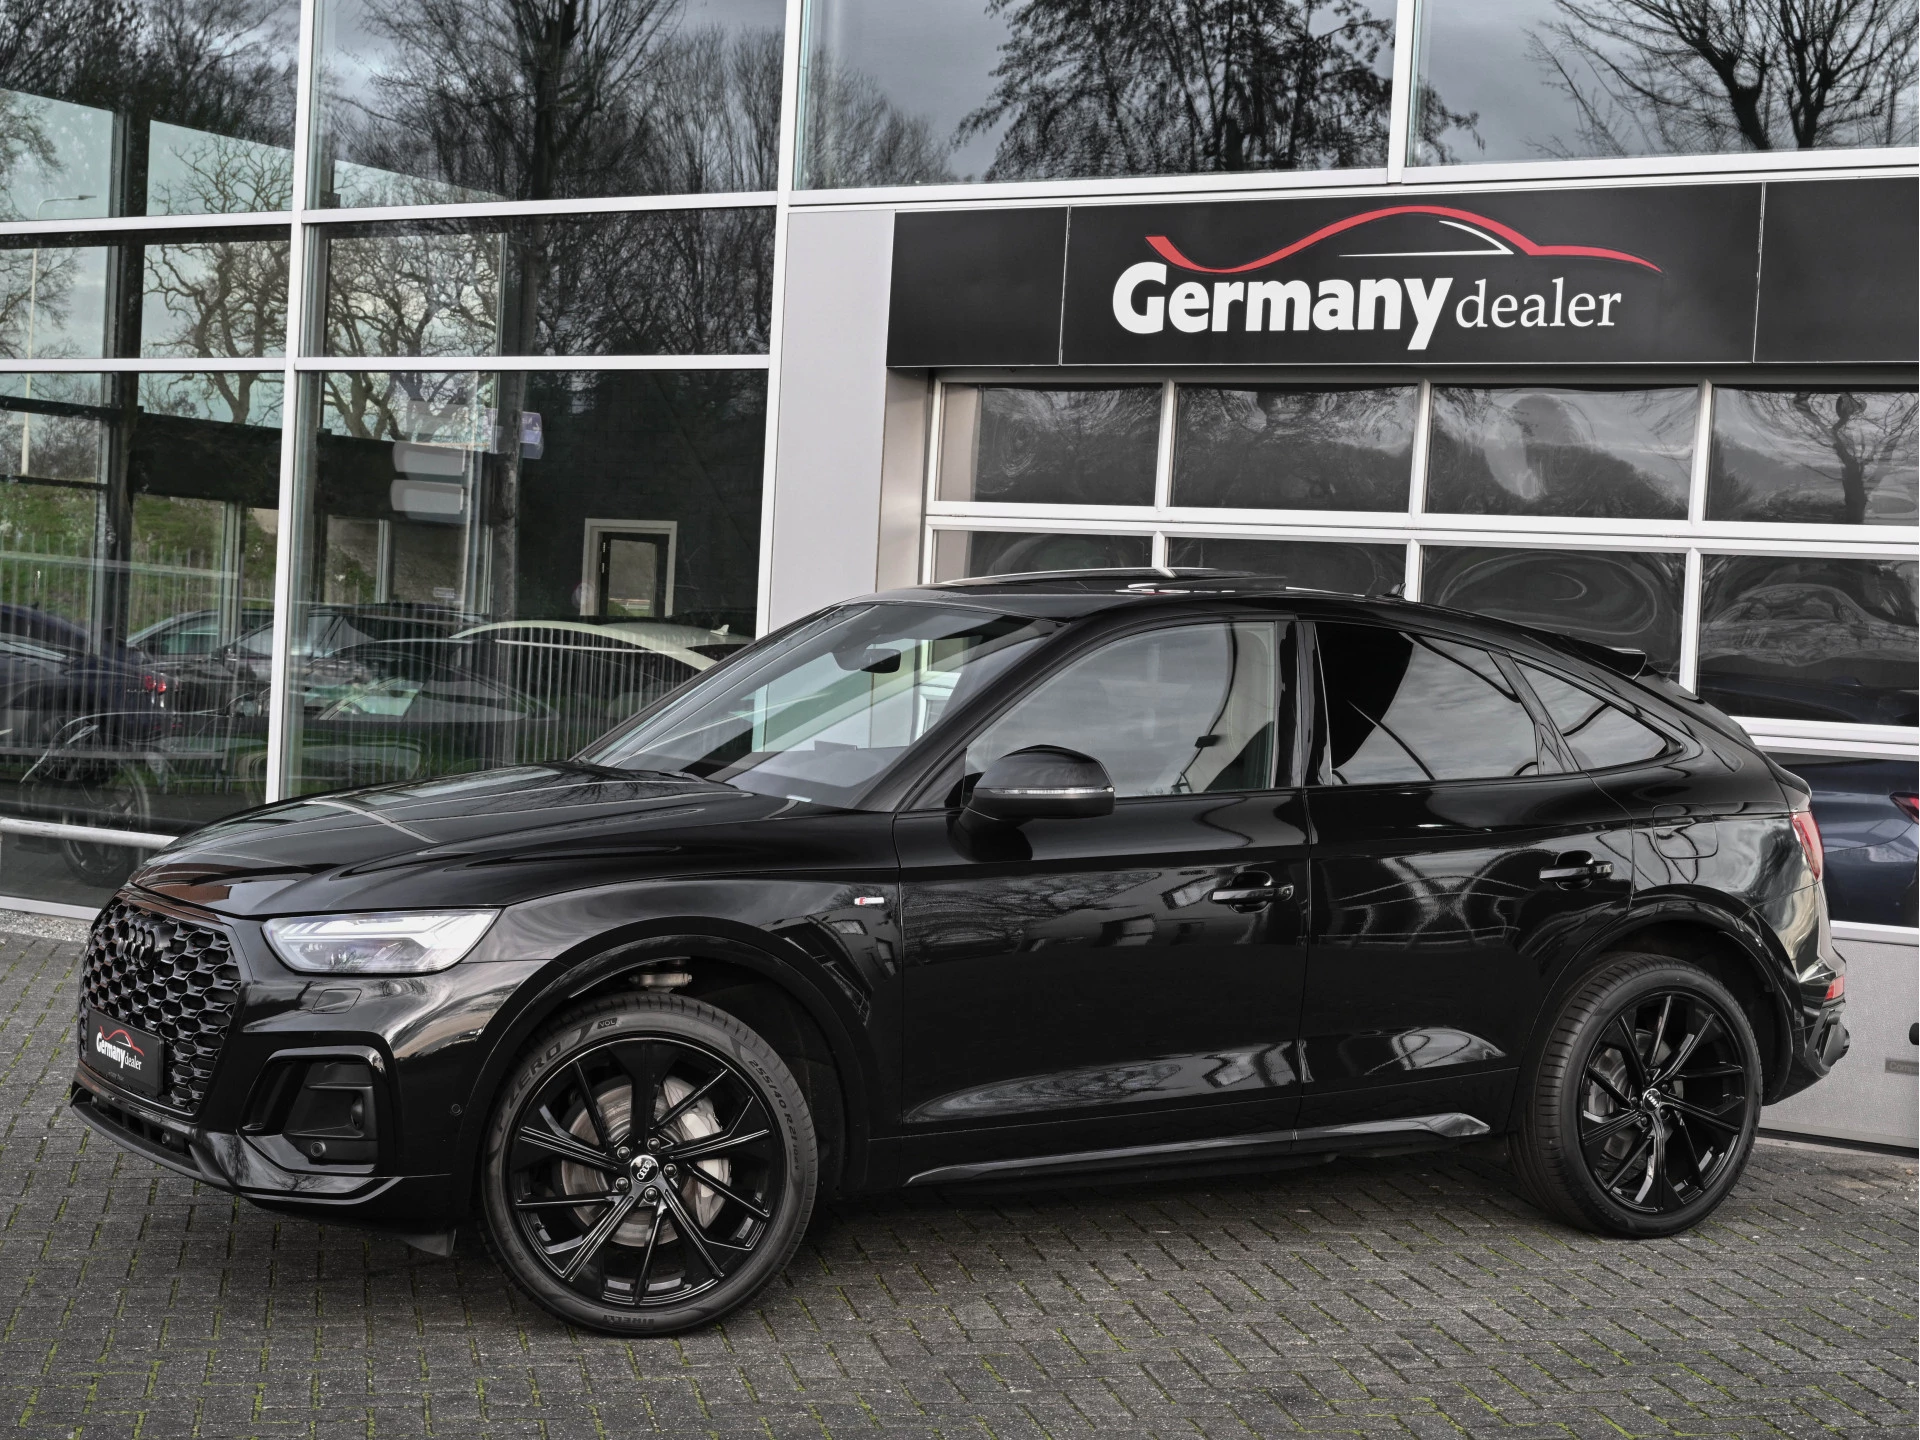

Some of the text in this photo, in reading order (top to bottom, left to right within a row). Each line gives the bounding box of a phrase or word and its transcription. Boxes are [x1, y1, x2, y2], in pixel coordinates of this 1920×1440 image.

[1112, 261, 1621, 350] Germany dealer
[599, 1019, 616, 1028] VOL
[96, 1031, 142, 1071] Germany dealer
[508, 1041, 562, 1109] ZERO
[748, 1059, 787, 1109] 255/40
